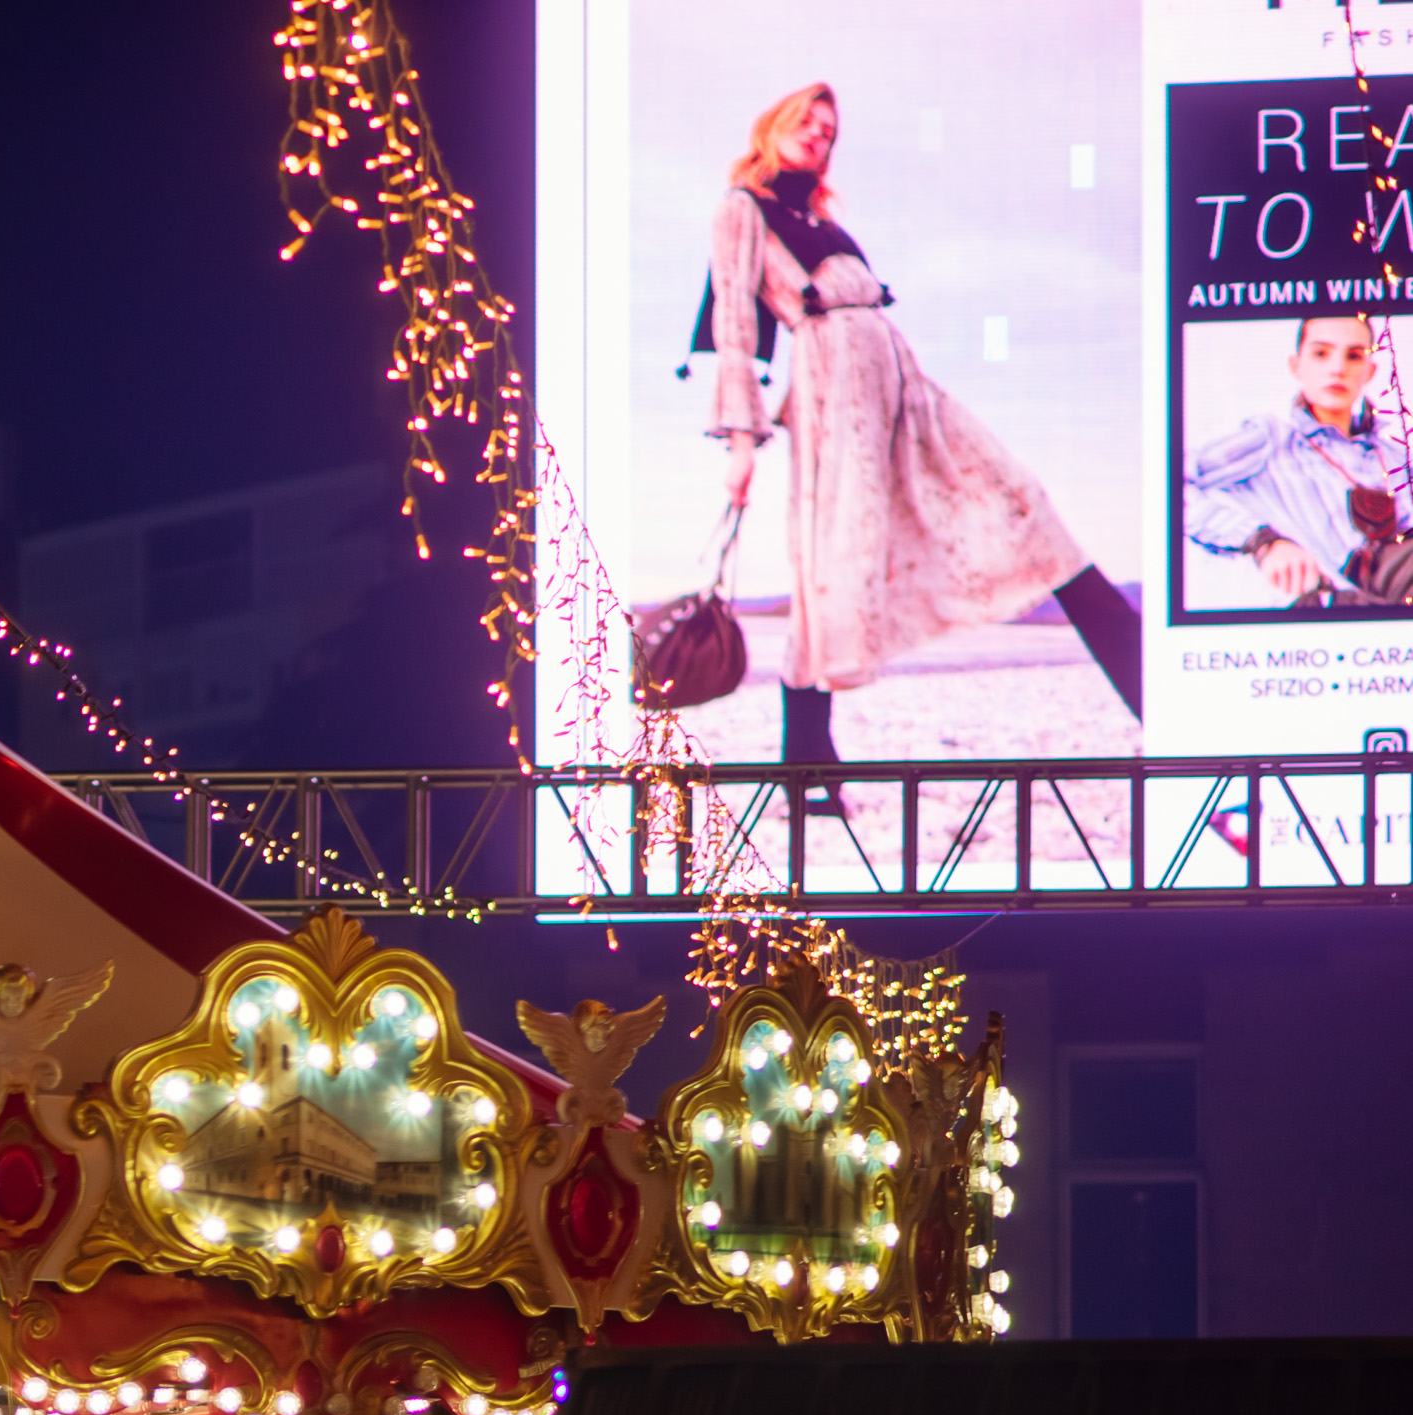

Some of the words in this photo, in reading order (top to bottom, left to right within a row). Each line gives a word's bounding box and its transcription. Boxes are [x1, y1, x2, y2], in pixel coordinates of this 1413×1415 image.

[1196, 192, 1312, 260] TO
[1188, 280, 1317, 307] AUTUMN
[1182, 651, 1259, 671] ELENA
[1266, 648, 1329, 669] MIRO
[1250, 676, 1325, 698] SFIZIO
